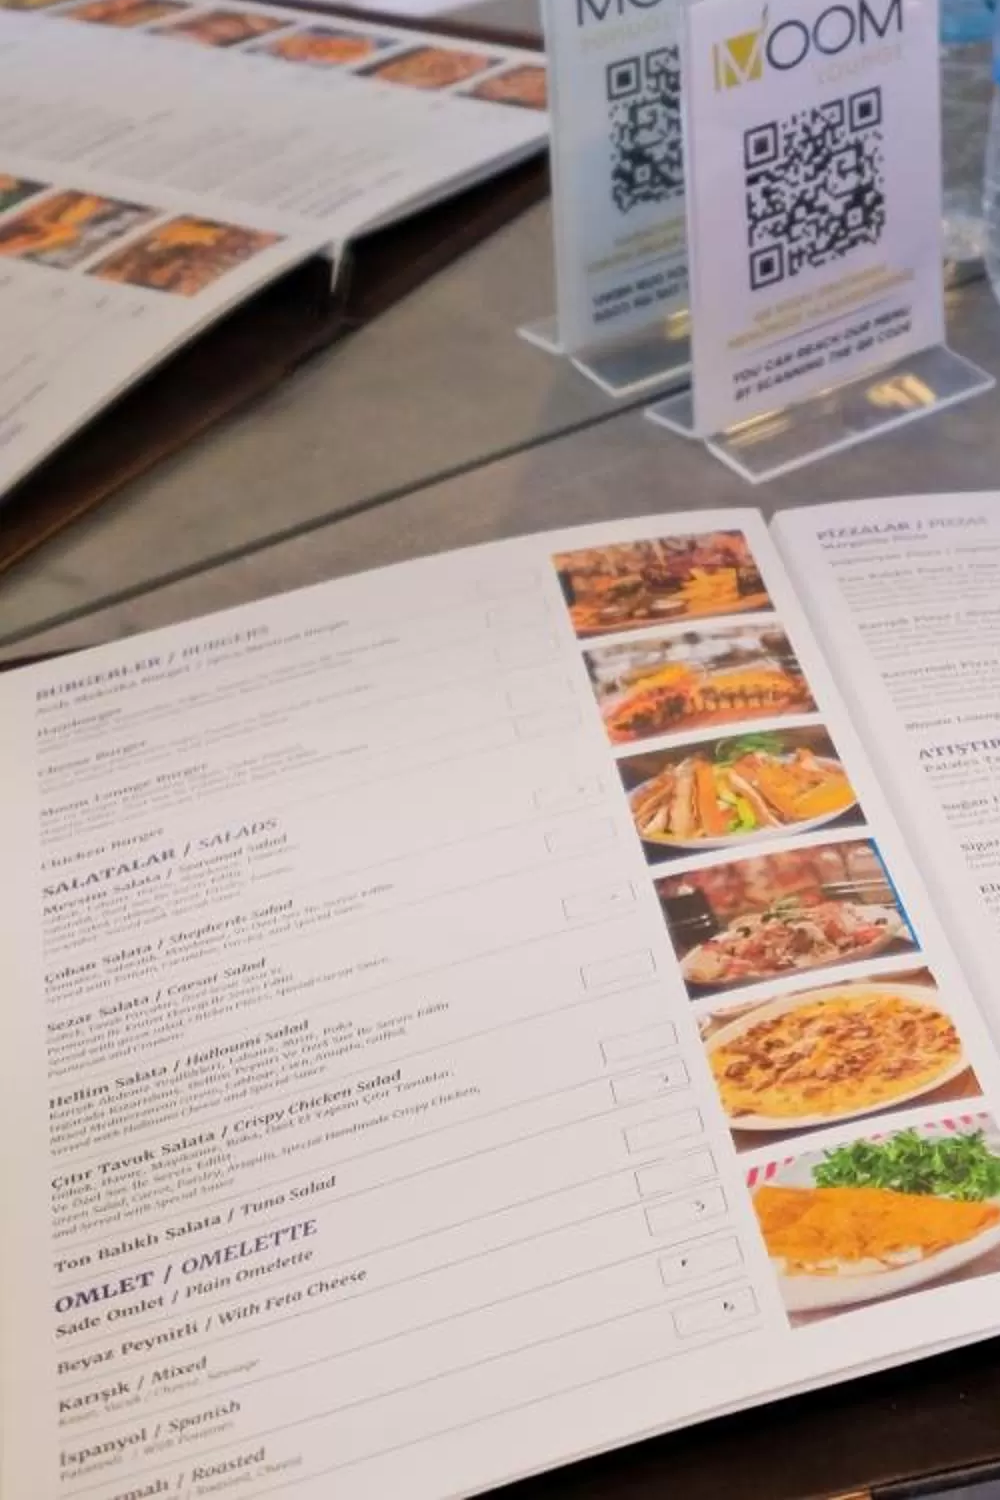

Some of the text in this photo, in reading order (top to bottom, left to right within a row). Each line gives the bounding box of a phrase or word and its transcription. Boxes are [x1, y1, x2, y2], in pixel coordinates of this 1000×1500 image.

[733, 305, 913, 384] YOU CAN REACH OUR MENU
[757, 357, 826, 392] SCANNING
[829, 346, 852, 364] THE
[877, 320, 913, 343] CODE
[43, 849, 175, 897] SALATALAR
[199, 816, 280, 848] SALADS
[99, 995, 148, 1016] Salata
[223, 959, 265, 978] Salad
[49, 1082, 109, 1108] Hellim
[115, 1065, 166, 1087] Salata
[265, 1021, 308, 1041] Salad
[98, 1149, 154, 1175] Tavuk
[161, 1131, 214, 1155] Salata
[234, 1109, 283, 1132] Crispy
[288, 1088, 350, 1115] Chicken
[356, 1072, 400, 1094] Salad
[55, 1251, 91, 1274] Ton
[164, 1212, 221, 1239] Salata
[241, 1192, 284, 1214] Tuna
[290, 1176, 335, 1199] Salad
[55, 1271, 154, 1313] OMLET
[181, 1220, 318, 1274] OMELETTE
[56, 1314, 101, 1338] Sade
[107, 1294, 163, 1322] Omlet
[186, 1274, 230, 1297] Plain
[236, 1248, 312, 1281] Omelette
[58, 1348, 113, 1375] Beyaz
[121, 1322, 198, 1354] Peynirli
[217, 1303, 259, 1326] With
[265, 1288, 301, 1312] Feta
[307, 1269, 367, 1298] Cheese
[151, 1357, 206, 1384] Mixed
[168, 1401, 240, 1432] Spanish
[192, 1449, 265, 1479] Roasted
